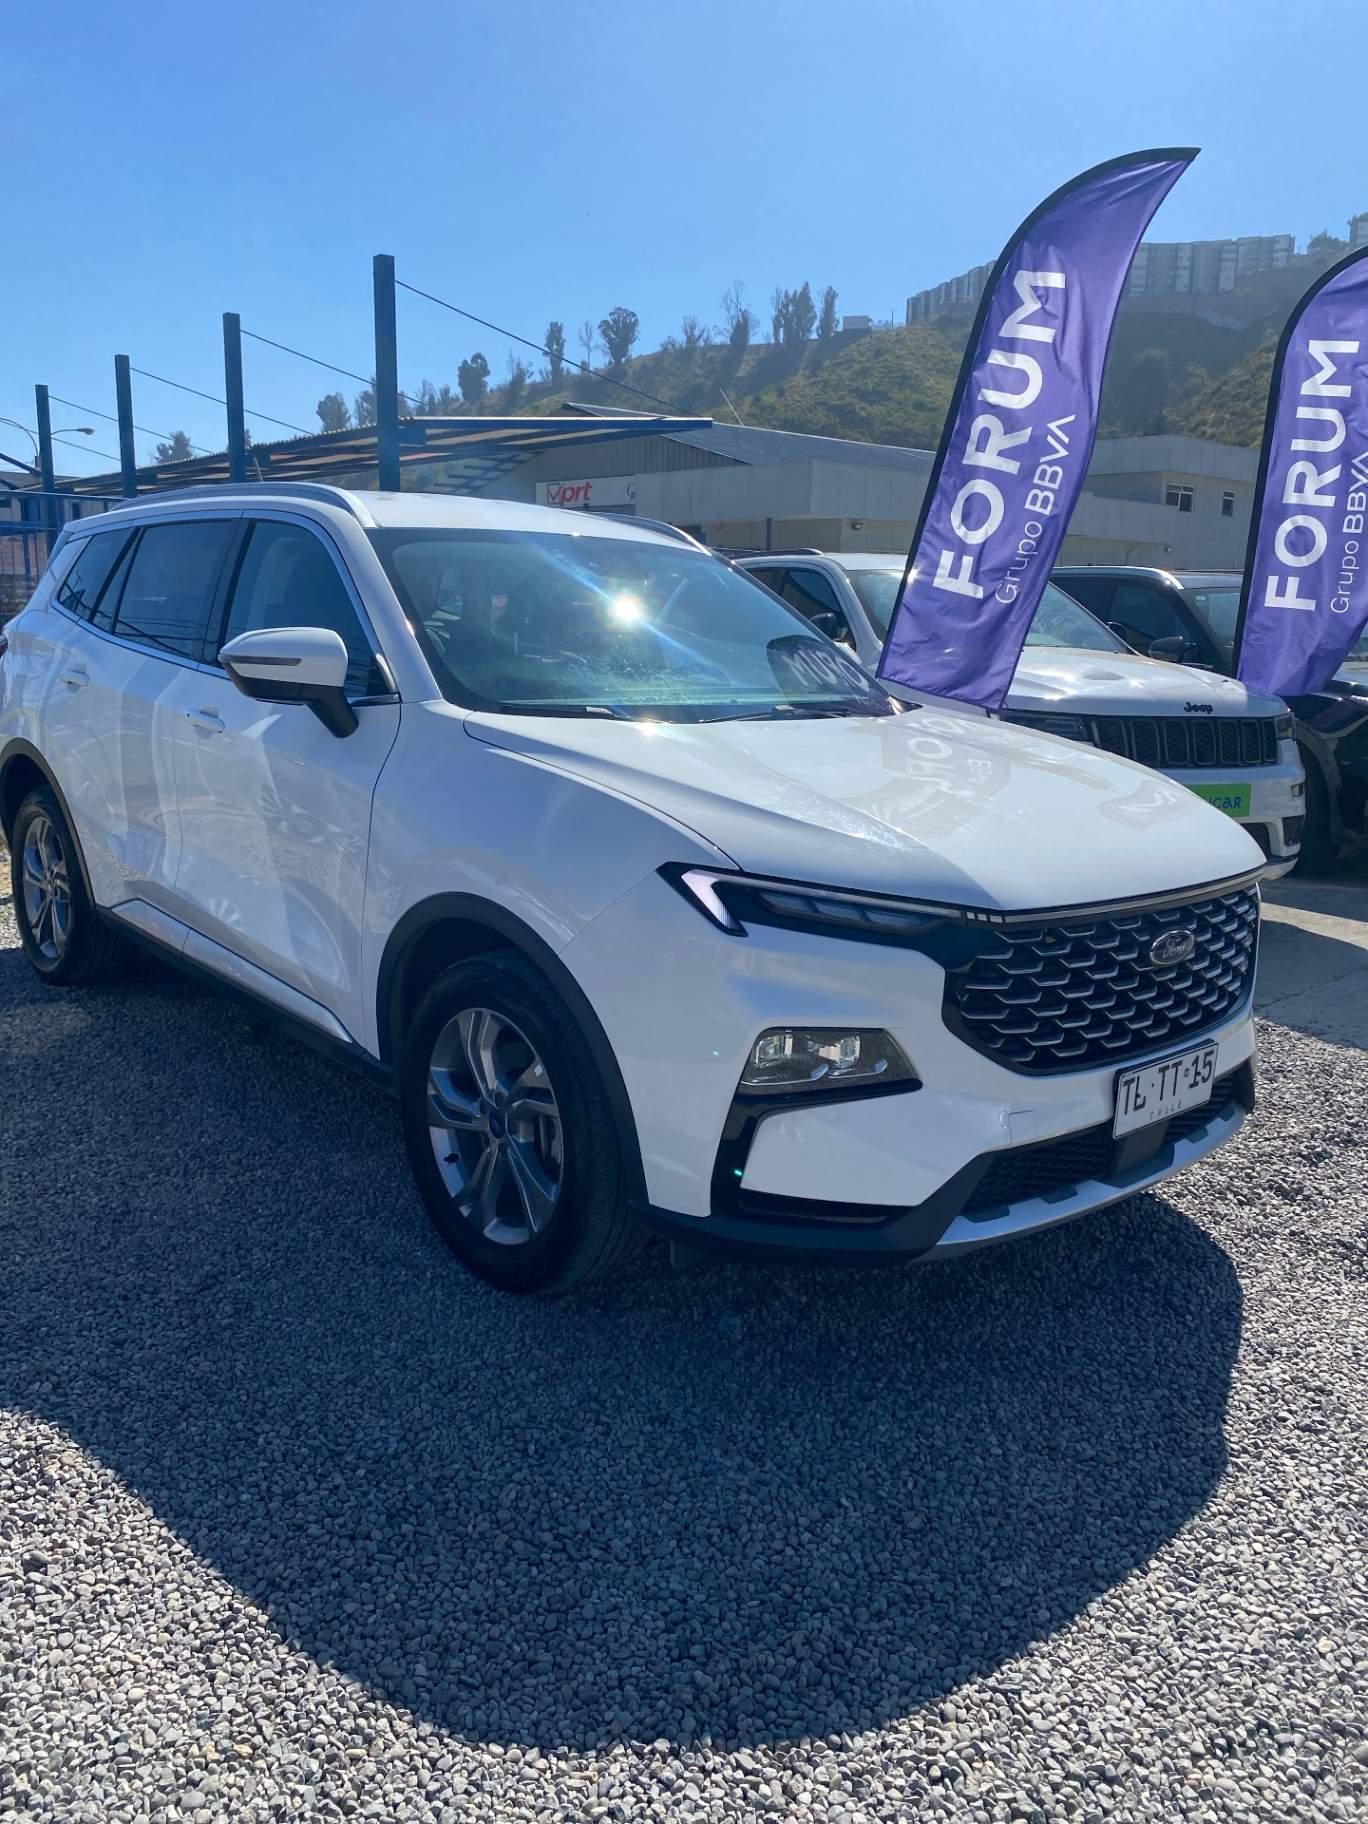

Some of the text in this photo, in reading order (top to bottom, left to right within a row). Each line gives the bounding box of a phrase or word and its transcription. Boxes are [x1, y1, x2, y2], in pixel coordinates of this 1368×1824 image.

[932, 270, 1066, 600] FORUM
[995, 414, 1076, 604] Grupo BBVA
[1264, 339, 1360, 612] FORUM
[1330, 540, 1360, 613] Grupo
[1183, 701, 1213, 714] Jeep
